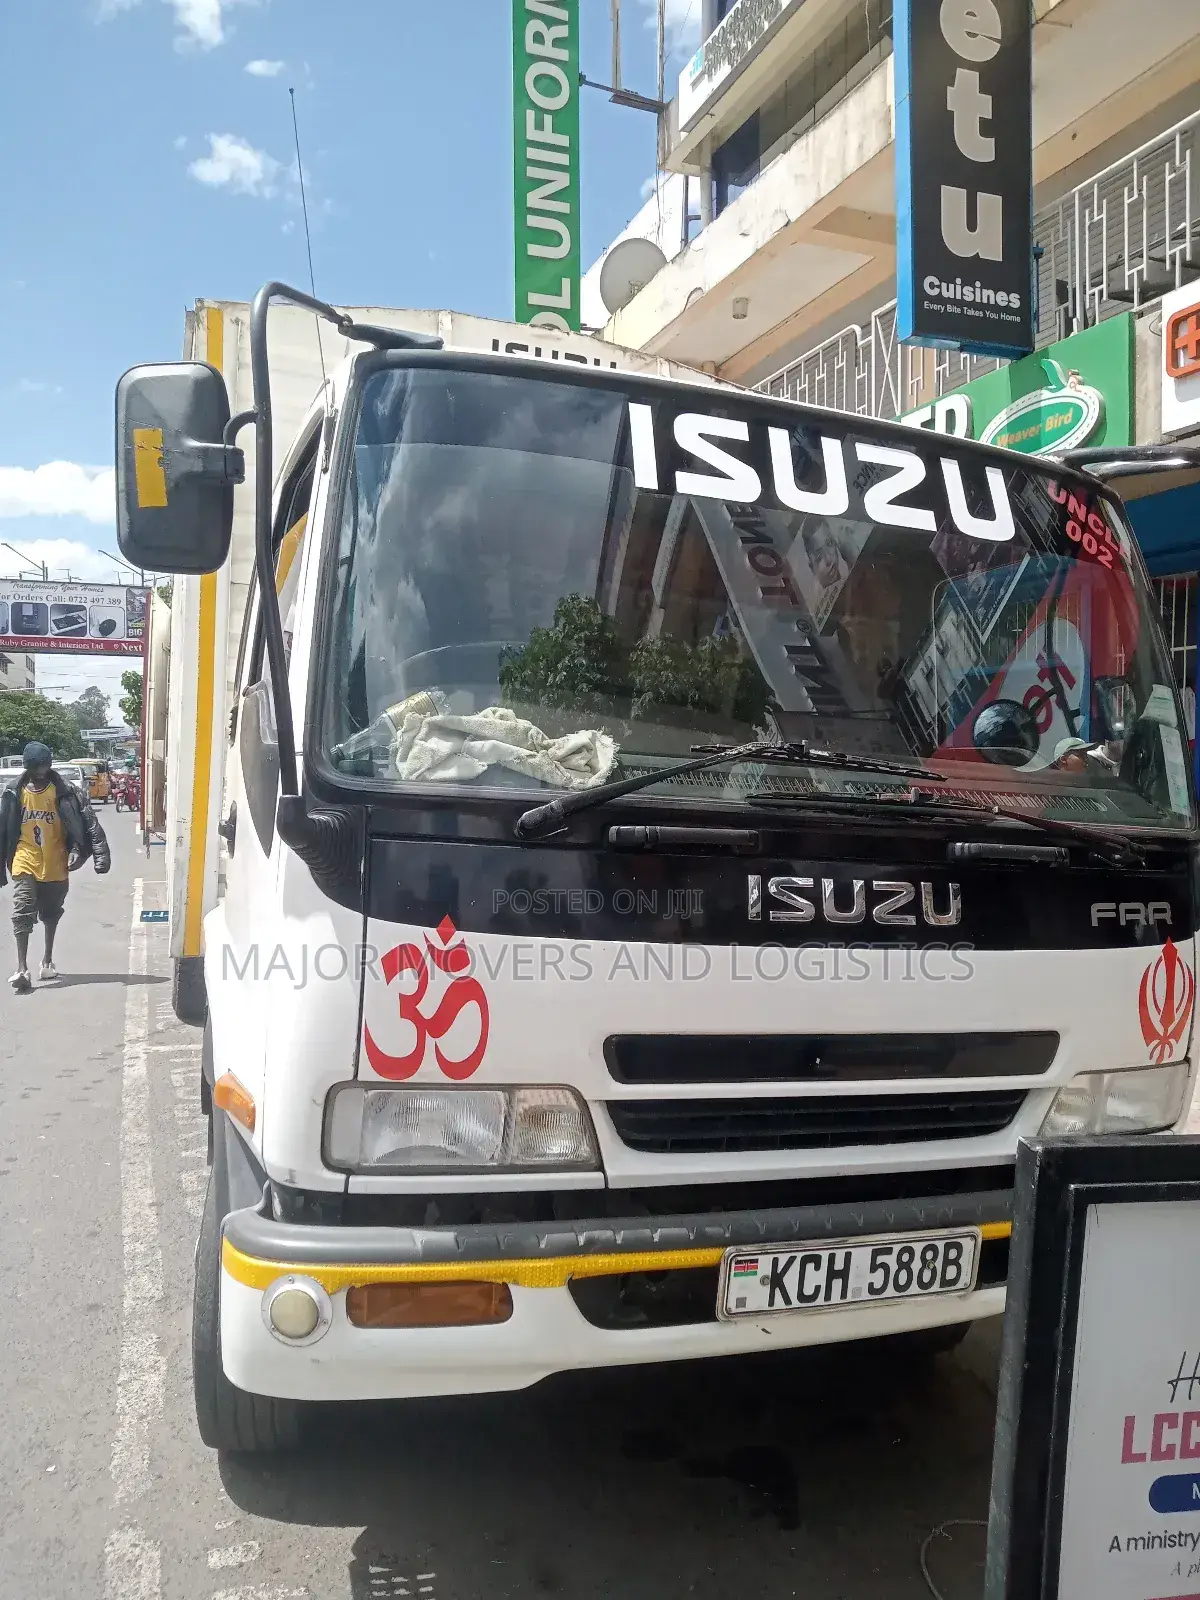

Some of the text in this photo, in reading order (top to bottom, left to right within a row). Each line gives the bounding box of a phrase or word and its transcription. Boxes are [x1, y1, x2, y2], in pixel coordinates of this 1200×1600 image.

[923, 275, 1021, 309] Cuisines
[923, 301, 1021, 322] Every Bite Takes You Home
[1045, 408, 1073, 432] Bird
[628, 402, 1017, 542] ISUZU
[1065, 519, 1114, 570] 002
[10, 580, 59, 592] Transforming
[13, 593, 44, 601] Orders
[45, 594, 67, 602] Call:
[68, 596, 88, 604] 0722
[90, 597, 105, 605] 497
[106, 597, 122, 605] 389
[0, 639, 104, 650] Ruby Granite & Interiors Ltd
[747, 874, 962, 927] ISUZU
[767, 1241, 964, 1308] KCH 588B
[1108, 1529, 1200, 1553] A ministry
[1170, 1561, 1181, 1577] A
